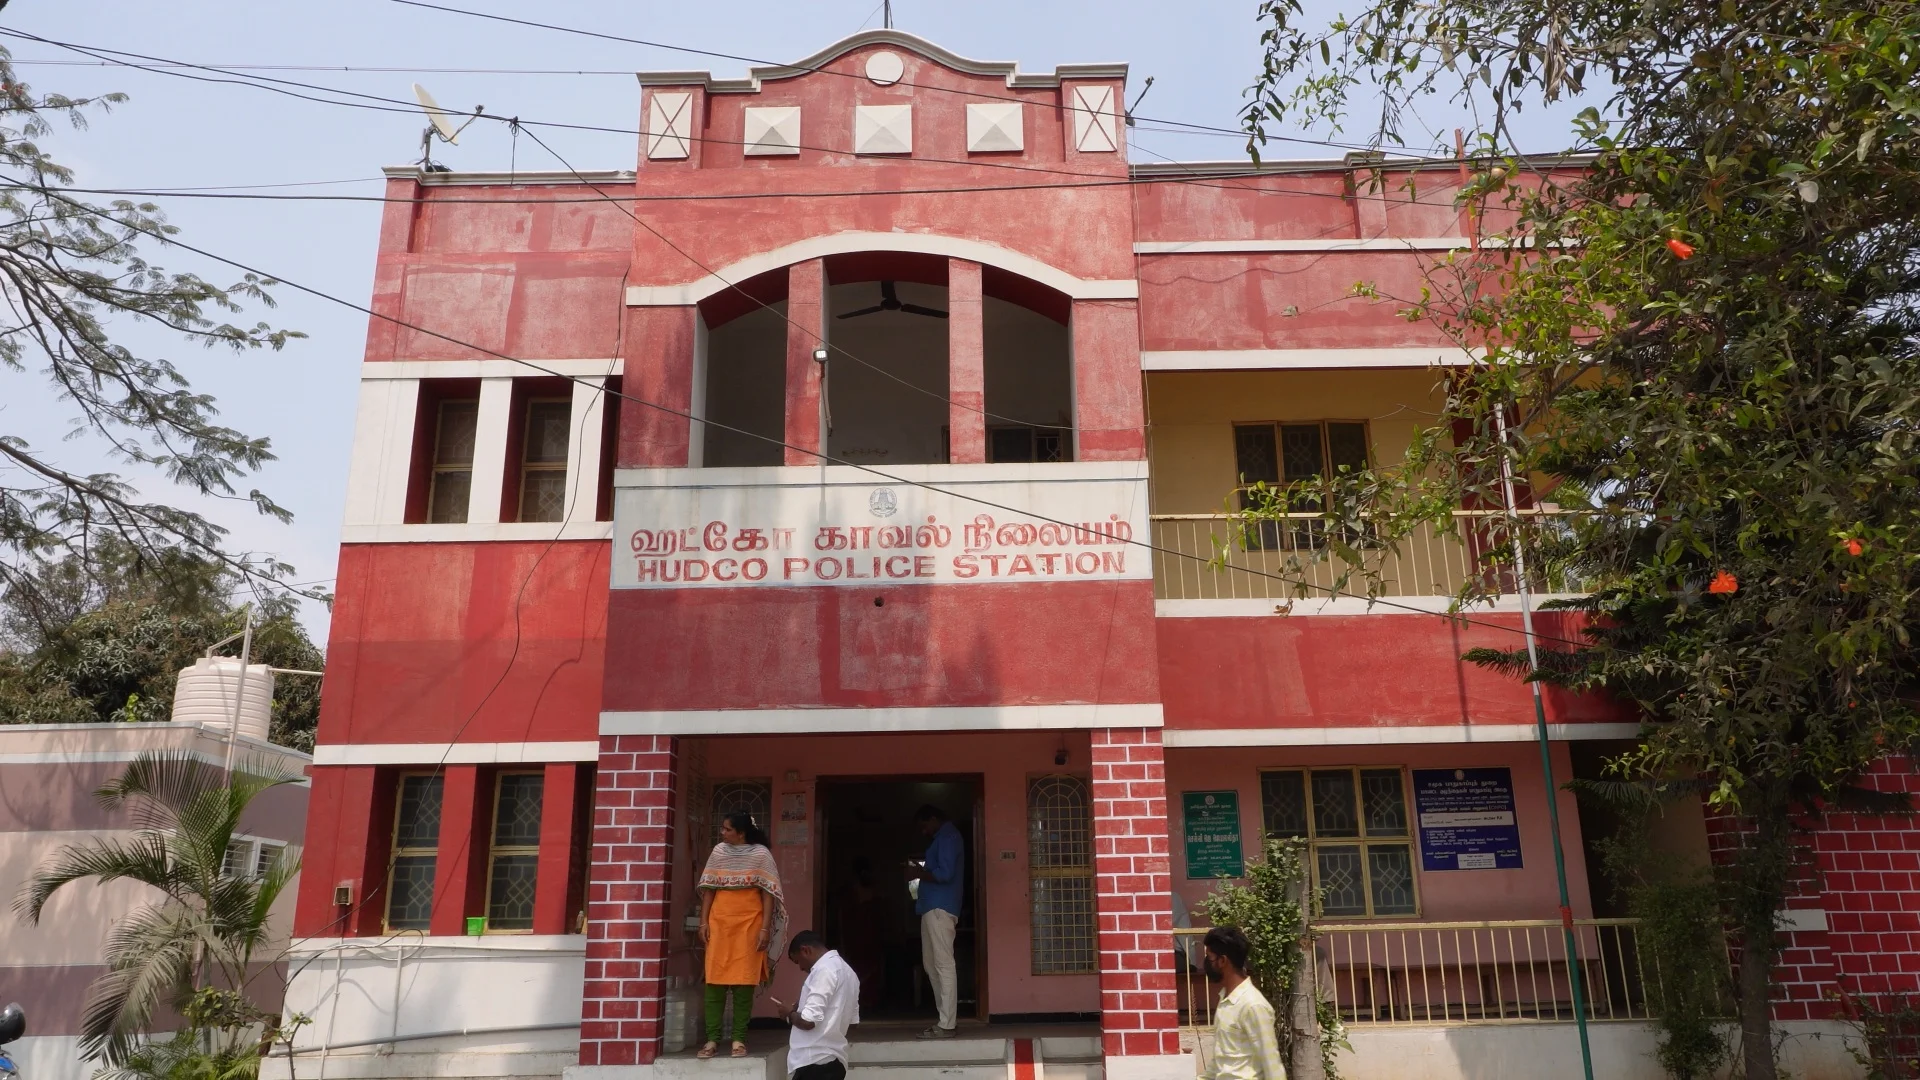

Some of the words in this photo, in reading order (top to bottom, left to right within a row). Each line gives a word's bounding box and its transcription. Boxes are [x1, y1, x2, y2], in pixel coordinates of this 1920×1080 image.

[630, 520, 797, 559] ஹட்கோ
[814, 515, 952, 551] காவல்
[963, 513, 1133, 553] நிலையம்
[637, 557, 769, 582] HUDCO
[783, 555, 936, 581] POLICE
[952, 551, 1127, 578] STATION
